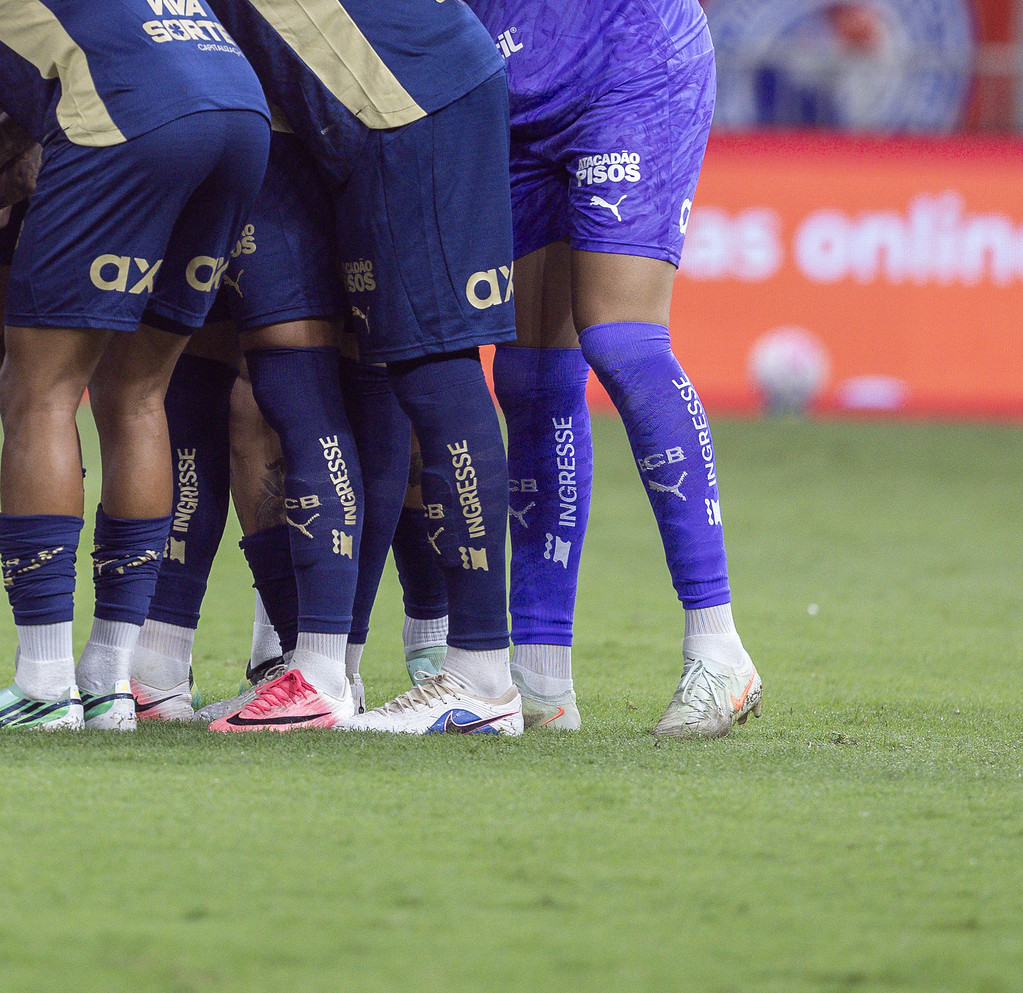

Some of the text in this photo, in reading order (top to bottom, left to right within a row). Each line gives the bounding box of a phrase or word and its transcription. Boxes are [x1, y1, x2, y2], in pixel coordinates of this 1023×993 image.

[141, 18, 238, 48] SORTE
[575, 163, 642, 188] PISOS
[577, 149, 641, 171] ATACADÃO
[793, 190, 1023, 288] onlin
[551, 416, 577, 528] INGRESSE
[671, 374, 717, 488] INGRESSE
[172, 448, 199, 533] INGRESSE
[318, 434, 358, 526] INGRESSE
[446, 439, 487, 540] INGRESSE
